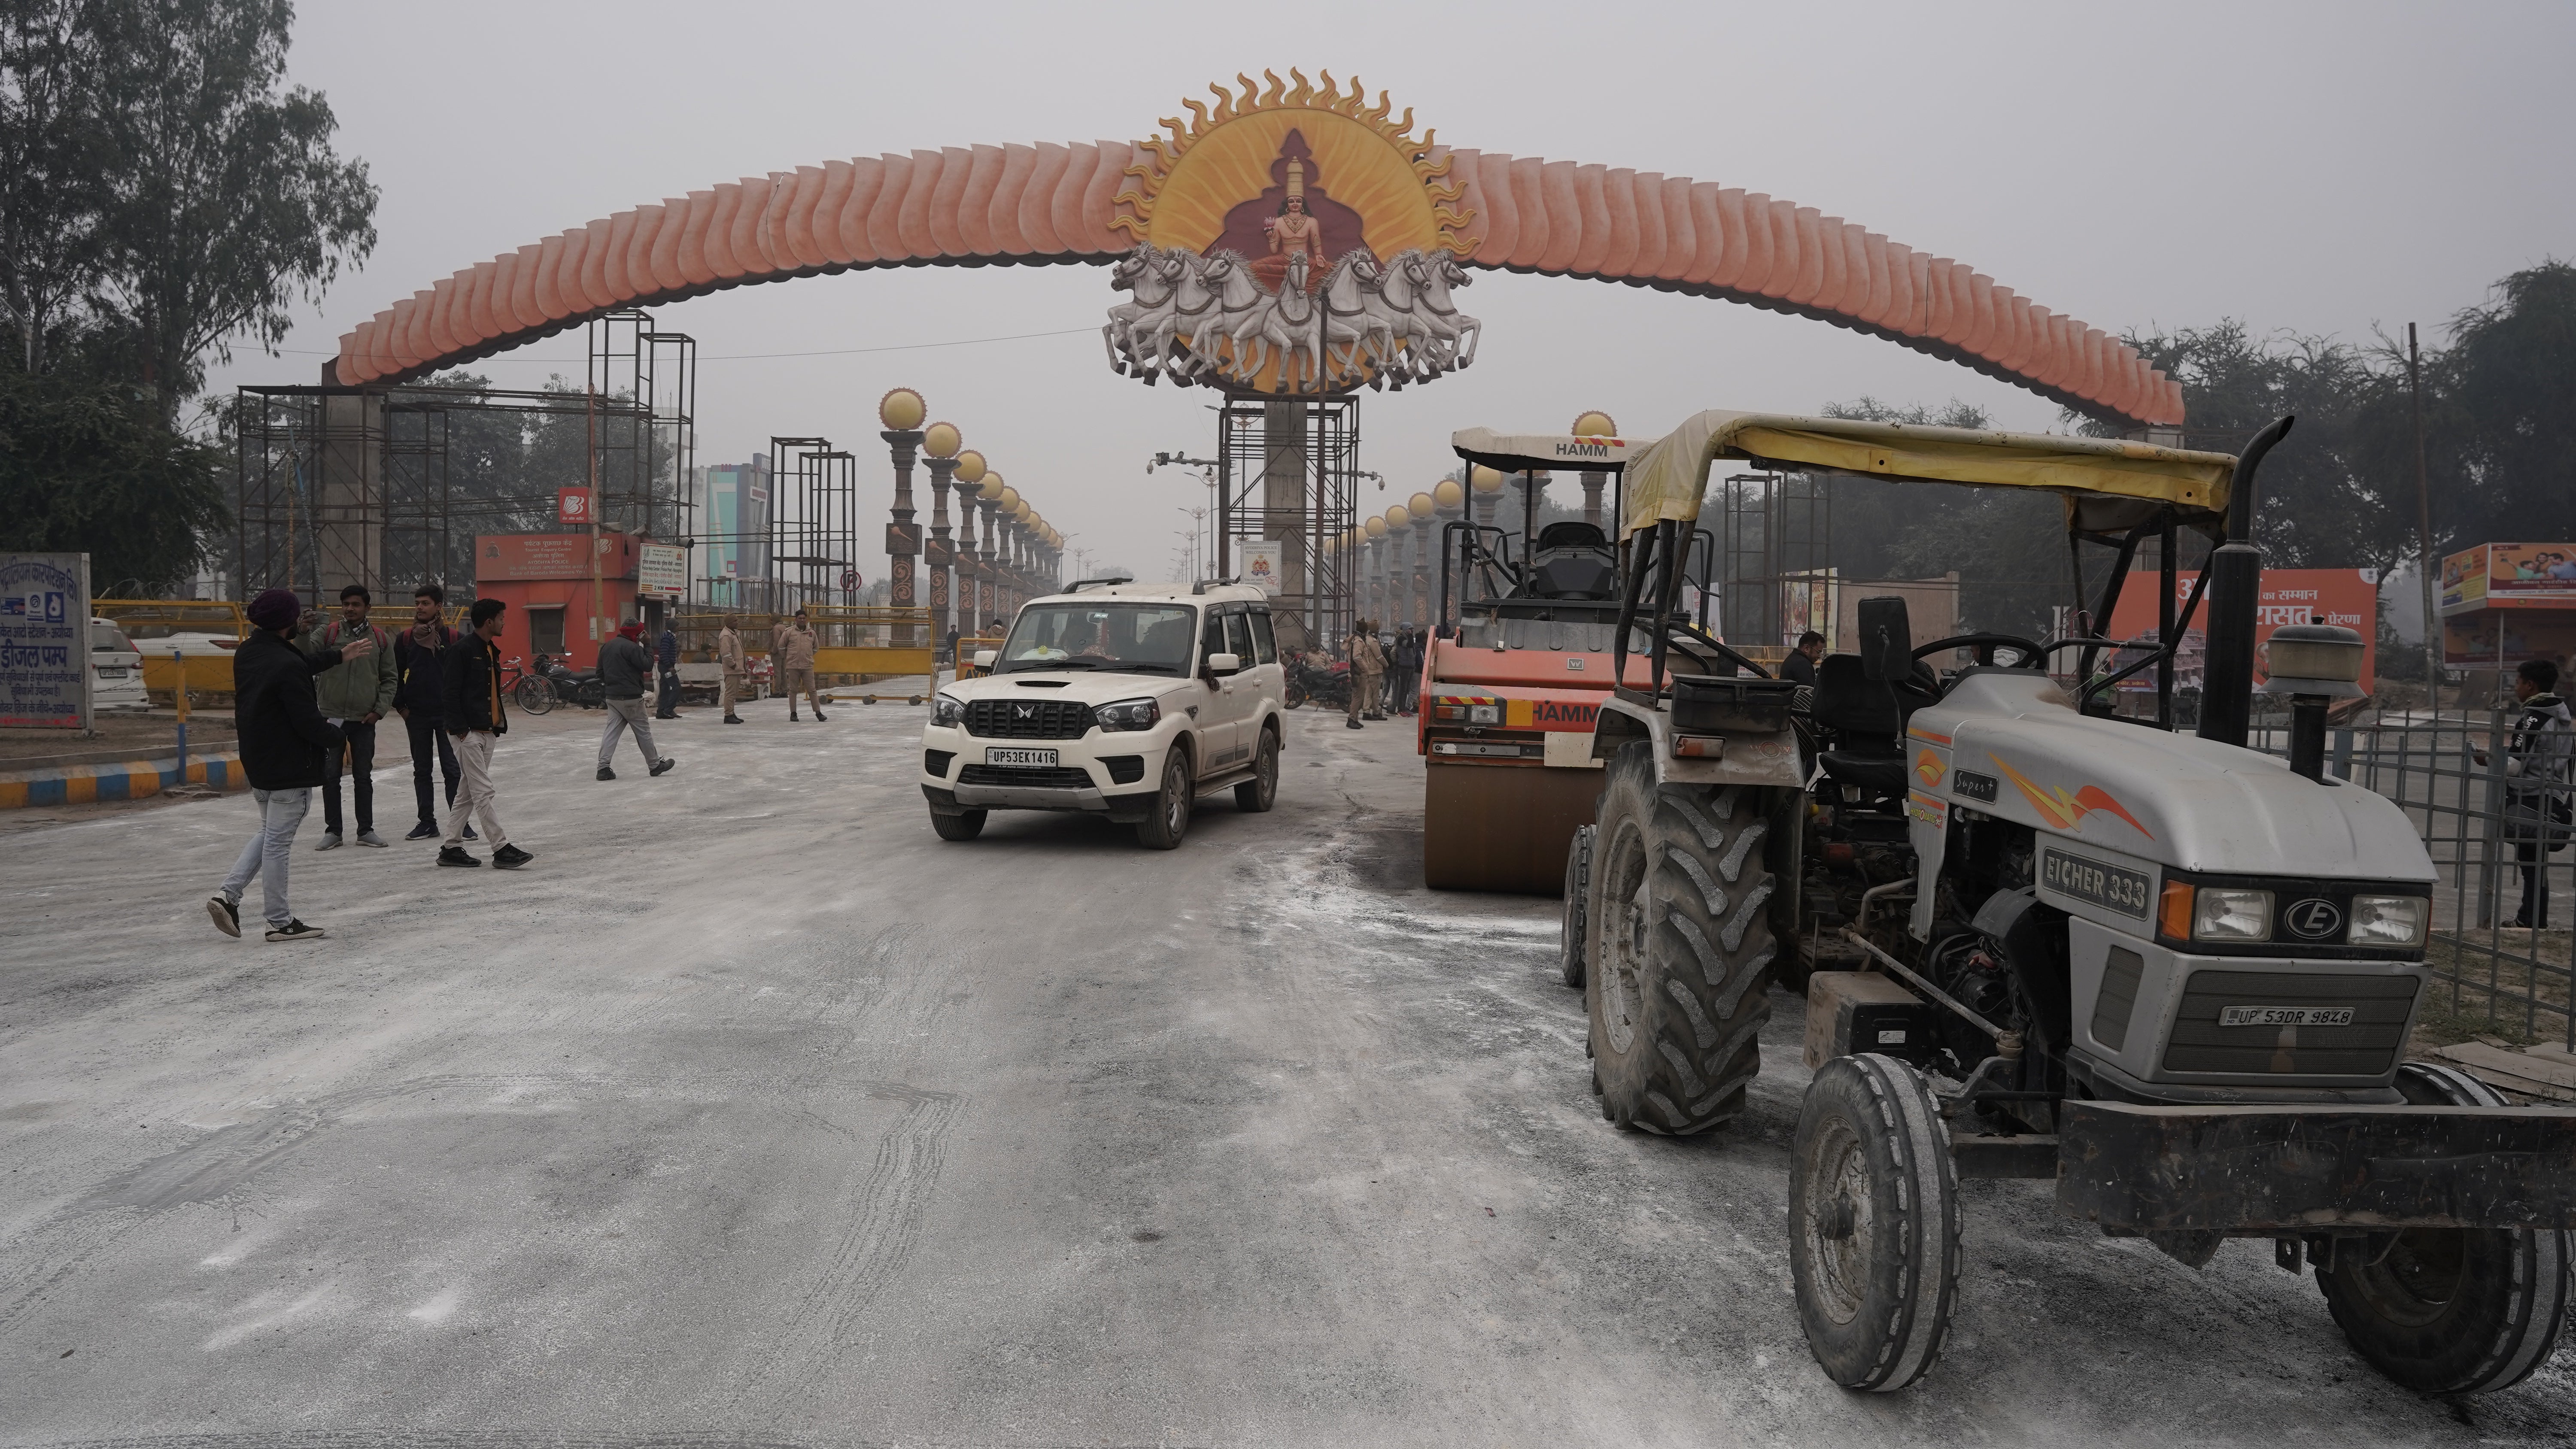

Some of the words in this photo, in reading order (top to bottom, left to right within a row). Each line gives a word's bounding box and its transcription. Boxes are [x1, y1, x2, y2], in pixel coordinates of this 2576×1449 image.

[1556, 444, 1607, 457] HAMM
[2263, 591, 2275, 600] का
[2277, 589, 2318, 600] सम्मान
[2257, 606, 2315, 625] रासत
[2328, 611, 2361, 626] प्रेरणा
[0, 638, 40, 668] डीजल
[41, 646, 67, 667] पम्प
[994, 751, 1055, 764] UP53EK1416
[1911, 807, 1936, 824] HYDROMATIC
[2045, 855, 2105, 898] EICHER
[2108, 875, 2146, 910] 333
[2264, 1010, 2306, 1024] 53DR
